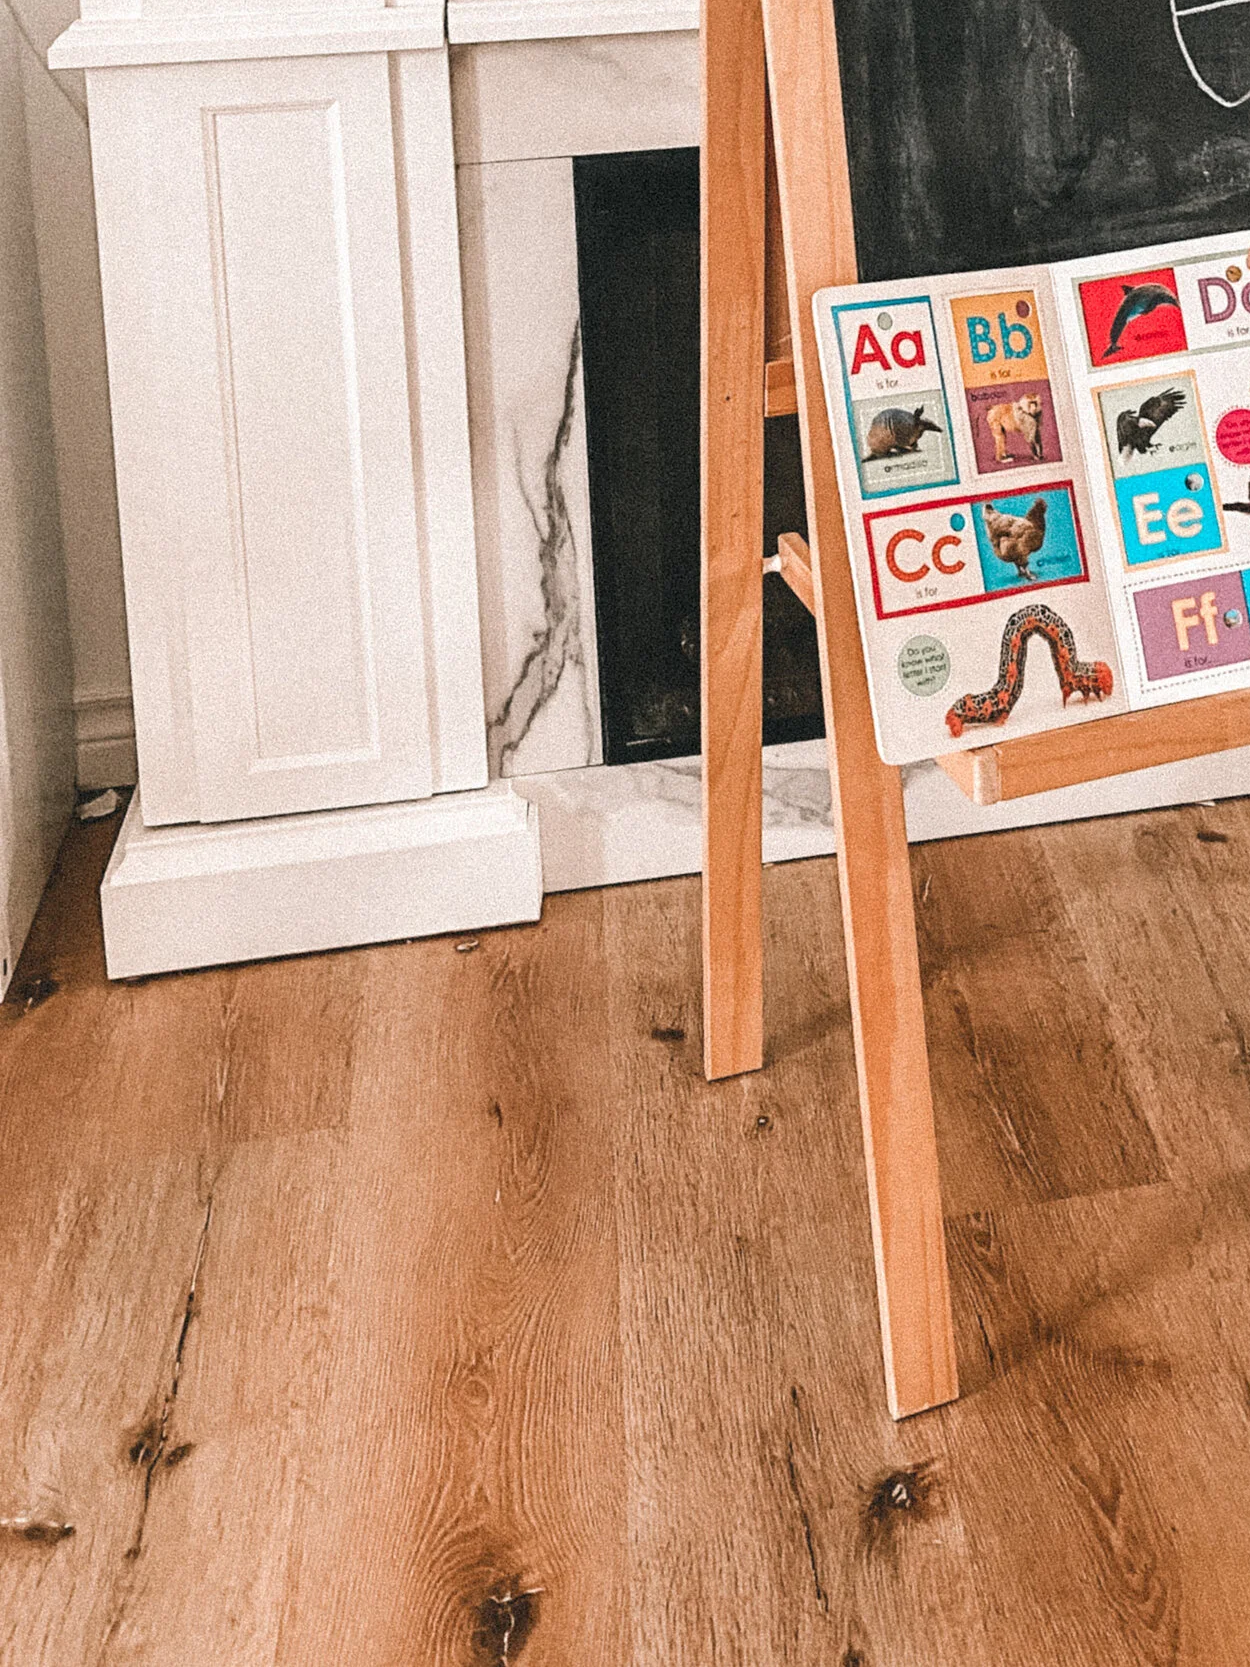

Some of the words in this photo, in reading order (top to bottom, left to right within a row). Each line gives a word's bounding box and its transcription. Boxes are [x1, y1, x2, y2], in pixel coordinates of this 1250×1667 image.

[850, 323, 927, 375] Aa
[965, 312, 1034, 364] Bb
[1132, 492, 1205, 546] Ee
[885, 528, 967, 583] Cc
[1170, 590, 1219, 651] Ff
